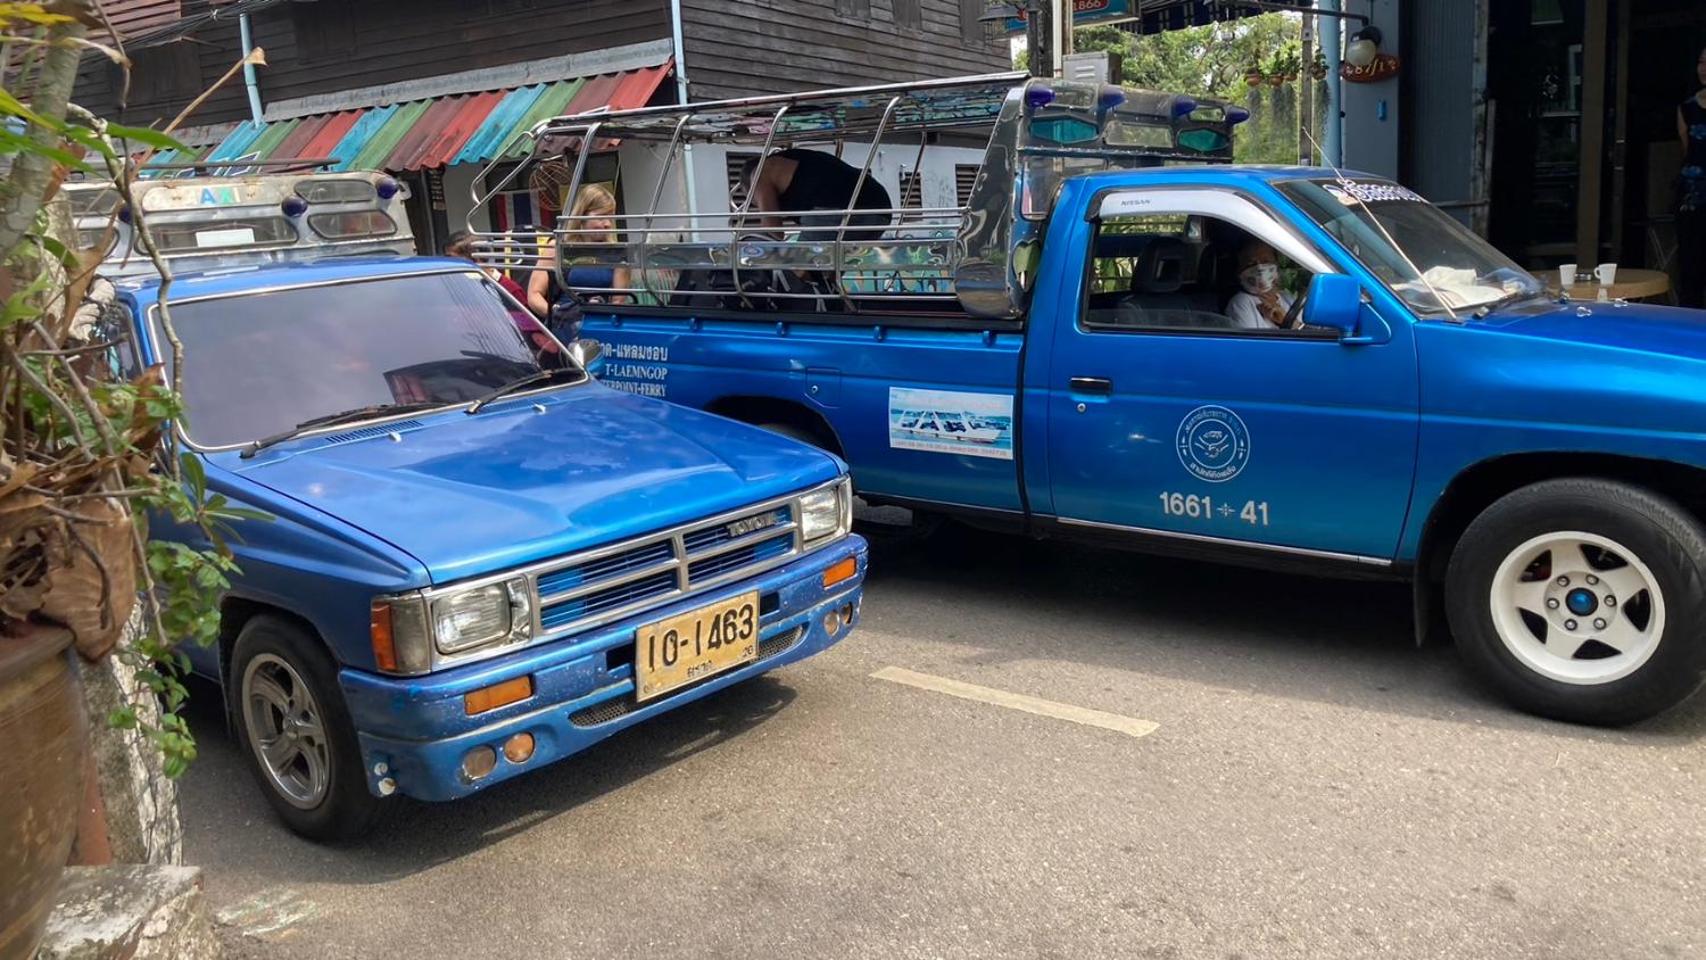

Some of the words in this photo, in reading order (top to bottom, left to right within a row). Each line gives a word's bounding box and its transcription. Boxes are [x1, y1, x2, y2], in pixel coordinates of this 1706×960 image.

[605, 363, 668, 380] T-LAEMNGOP
[1160, 491, 1212, 519] 1661
[1240, 500, 1268, 526] 41
[727, 512, 776, 537] TOYOTA
[648, 603, 754, 674] 10-1463
